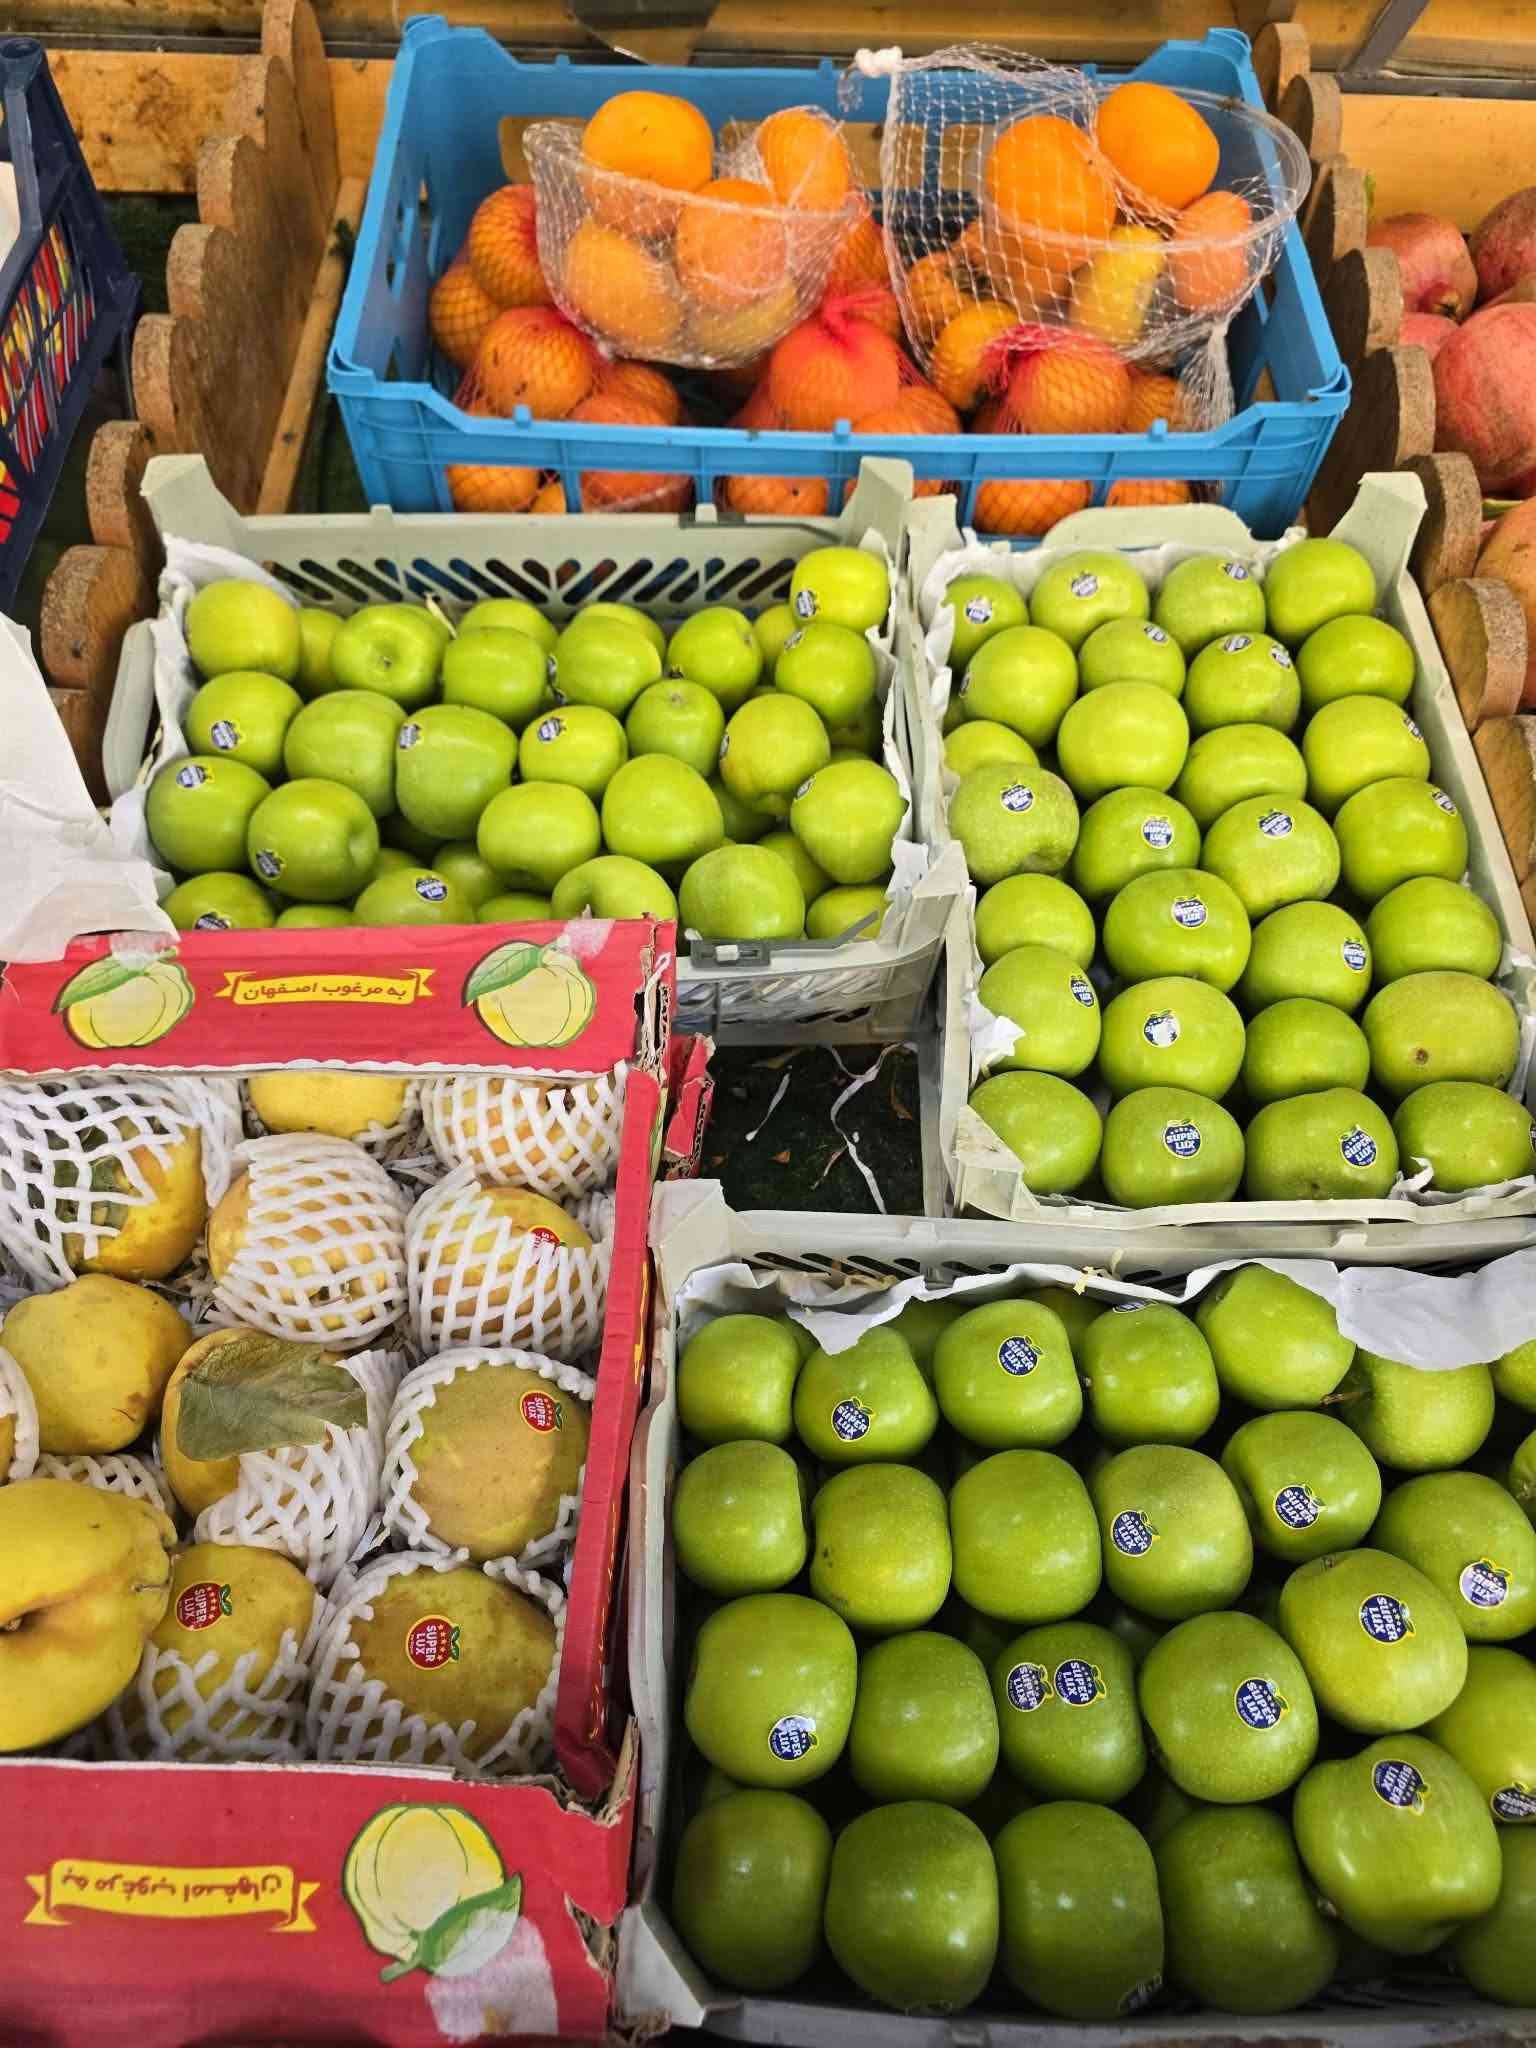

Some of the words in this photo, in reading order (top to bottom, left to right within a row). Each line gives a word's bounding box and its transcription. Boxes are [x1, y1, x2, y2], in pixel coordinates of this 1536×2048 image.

[243, 982, 318, 1000] اصفهان
[322, 982, 383, 998] مرغوب
[386, 984, 407, 1000] به
[1166, 1132, 1199, 1143] SUPER
[1175, 1140, 1196, 1149] LUX
[1345, 1135, 1370, 1158] SUPER
[1355, 1145, 1372, 1161] LUX
[1004, 1350, 1024, 1370] LUX
[1007, 1340, 1033, 1370] SUPER
[527, 1401, 537, 1419] LUX
[534, 1397, 545, 1426] SUPER
[837, 1405, 867, 1432] SUPER
[835, 1417, 856, 1434] LUX
[1281, 1502, 1300, 1521] LUX
[1284, 1490, 1314, 1521] SUPER
[1119, 1527, 1136, 1550] LUX
[1121, 1514, 1147, 1550] SUPER
[184, 1598, 195, 1620] LUX
[194, 1588, 207, 1622] SUPER
[1369, 1607, 1385, 1633] LUX
[1377, 1597, 1398, 1640] SUPER
[416, 1632, 426, 1655] LUX
[425, 1625, 437, 1661] SUPER
[1013, 1678, 1027, 1702] LUX
[1020, 1666, 1037, 1706] SUPER
[1063, 1672, 1077, 1695] LUX
[1070, 1662, 1089, 1702] SUPER
[1242, 1695, 1263, 1720] LUX
[1246, 1681, 1275, 1724] SUPER
[779, 1730, 791, 1753] LUX
[786, 1720, 802, 1757] SUPER
[1382, 1766, 1399, 1790] LUX
[1390, 1765, 1412, 1804] SUPER
[61, 1867, 88, 1891] به
[95, 1873, 175, 1901] مرغوب
[183, 1873, 282, 1904] اصفهان
